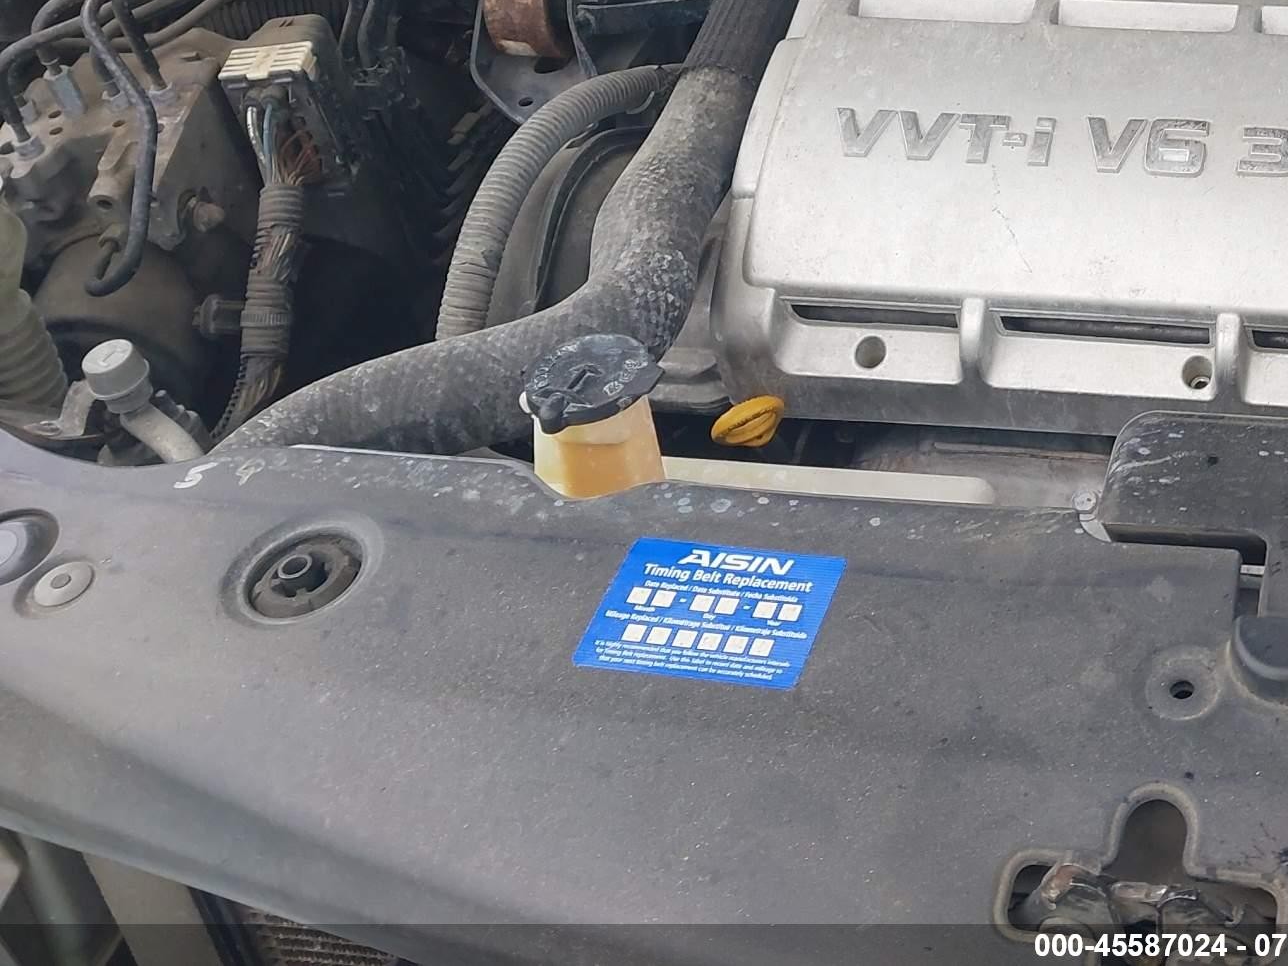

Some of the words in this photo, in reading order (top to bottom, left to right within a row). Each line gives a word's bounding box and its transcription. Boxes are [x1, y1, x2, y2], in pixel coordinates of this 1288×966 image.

[836, 107, 1057, 167] VVT-i
[1087, 116, 1211, 178] V6
[677, 549, 795, 576] AISIN
[645, 563, 690, 581] Timing
[693, 569, 721, 583] Belt
[722, 573, 814, 593] Replacement
